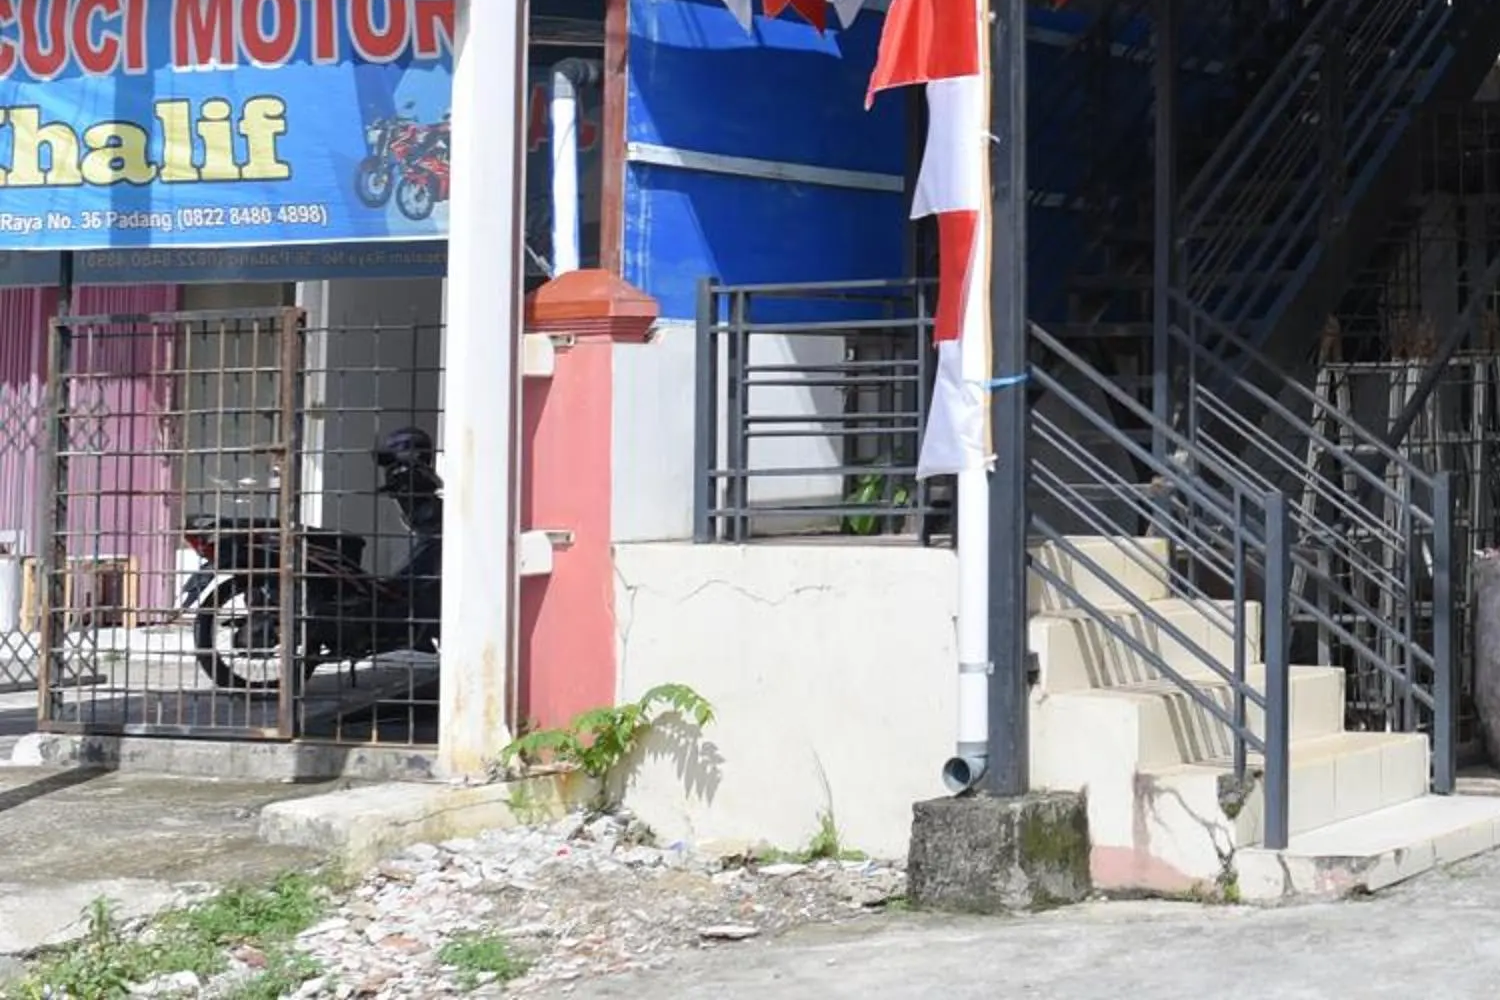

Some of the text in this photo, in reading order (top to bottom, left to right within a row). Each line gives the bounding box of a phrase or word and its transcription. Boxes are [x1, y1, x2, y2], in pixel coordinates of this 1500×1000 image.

[0, 94, 291, 188] halif
[0, 211, 42, 235] Raya
[47, 211, 77, 231] No.
[106, 208, 173, 232] Padang
[176, 206, 225, 230] (0822
[229, 206, 272, 226] 8480
[277, 203, 328, 226] 4898)
